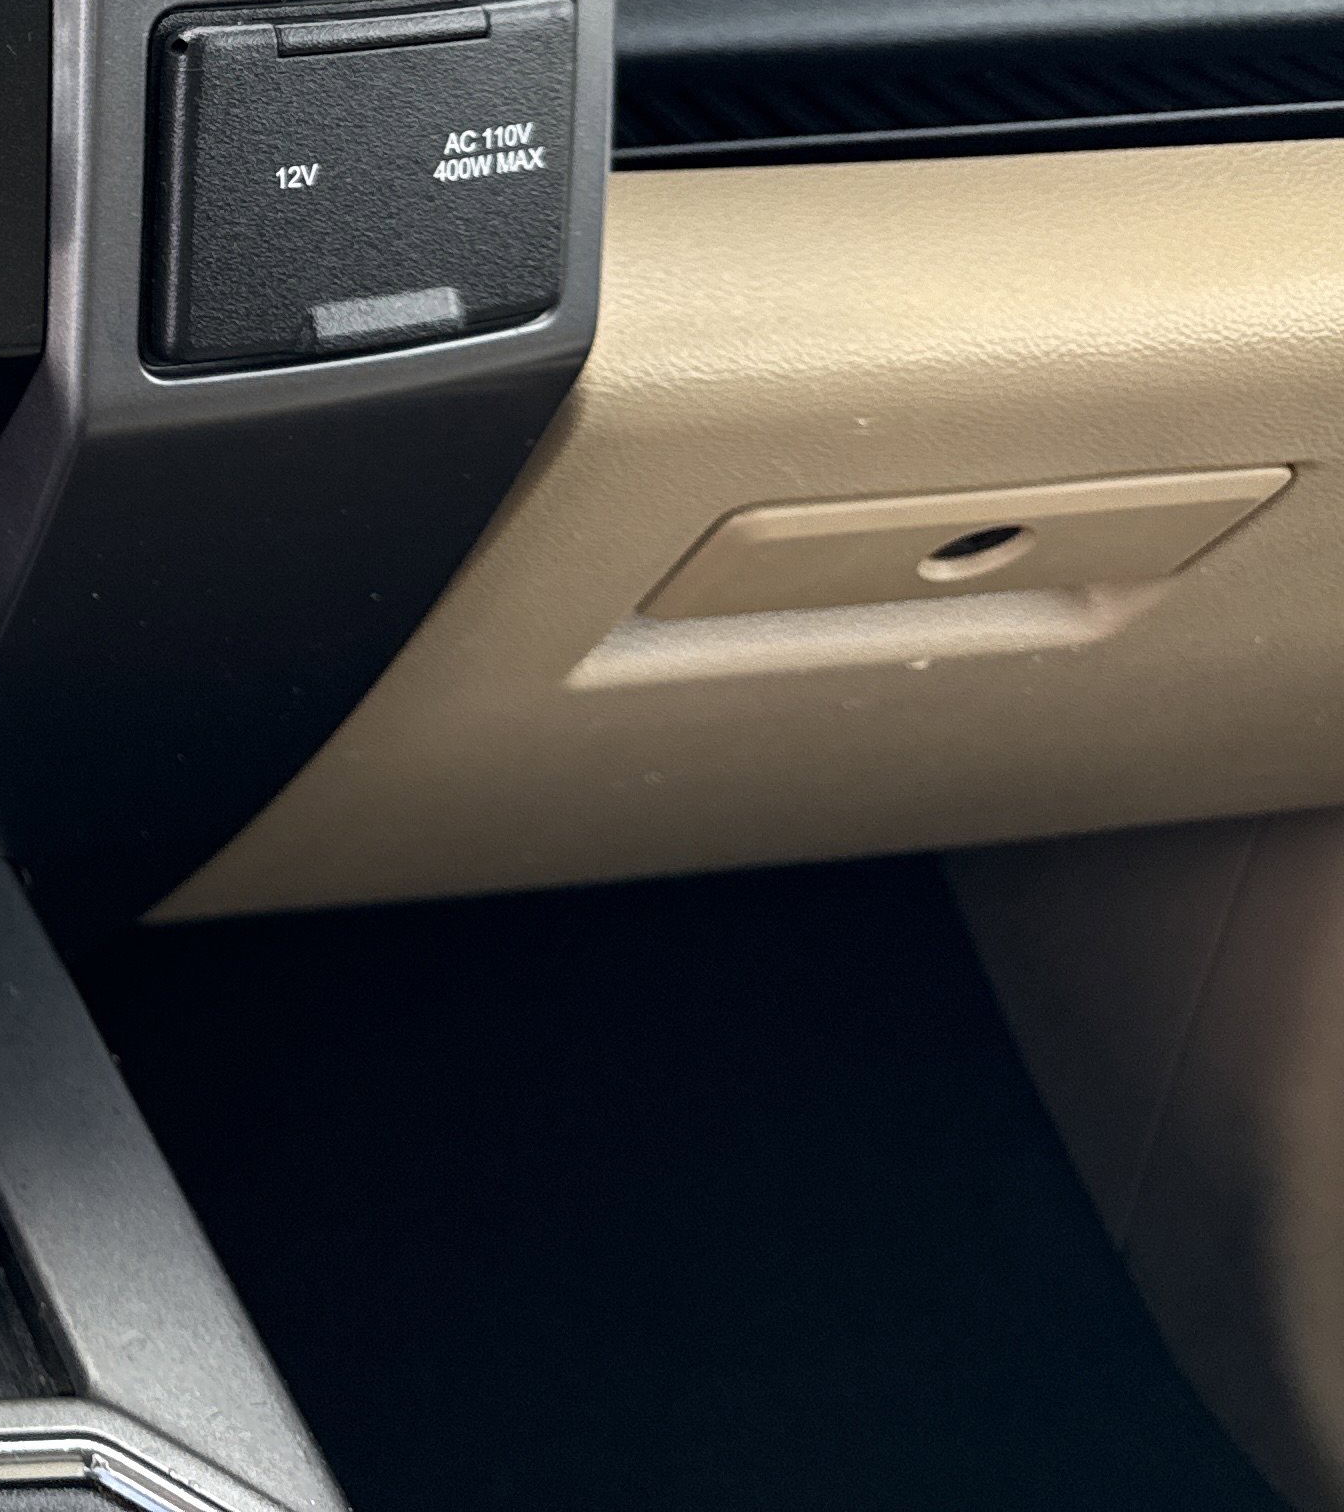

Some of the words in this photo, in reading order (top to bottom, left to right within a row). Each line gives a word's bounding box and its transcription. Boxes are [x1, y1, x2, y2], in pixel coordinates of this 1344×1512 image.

[444, 129, 477, 156] AC
[482, 122, 535, 150] 110V
[275, 163, 319, 190] 12V
[433, 154, 494, 183] 400W
[495, 147, 546, 174] MAX
